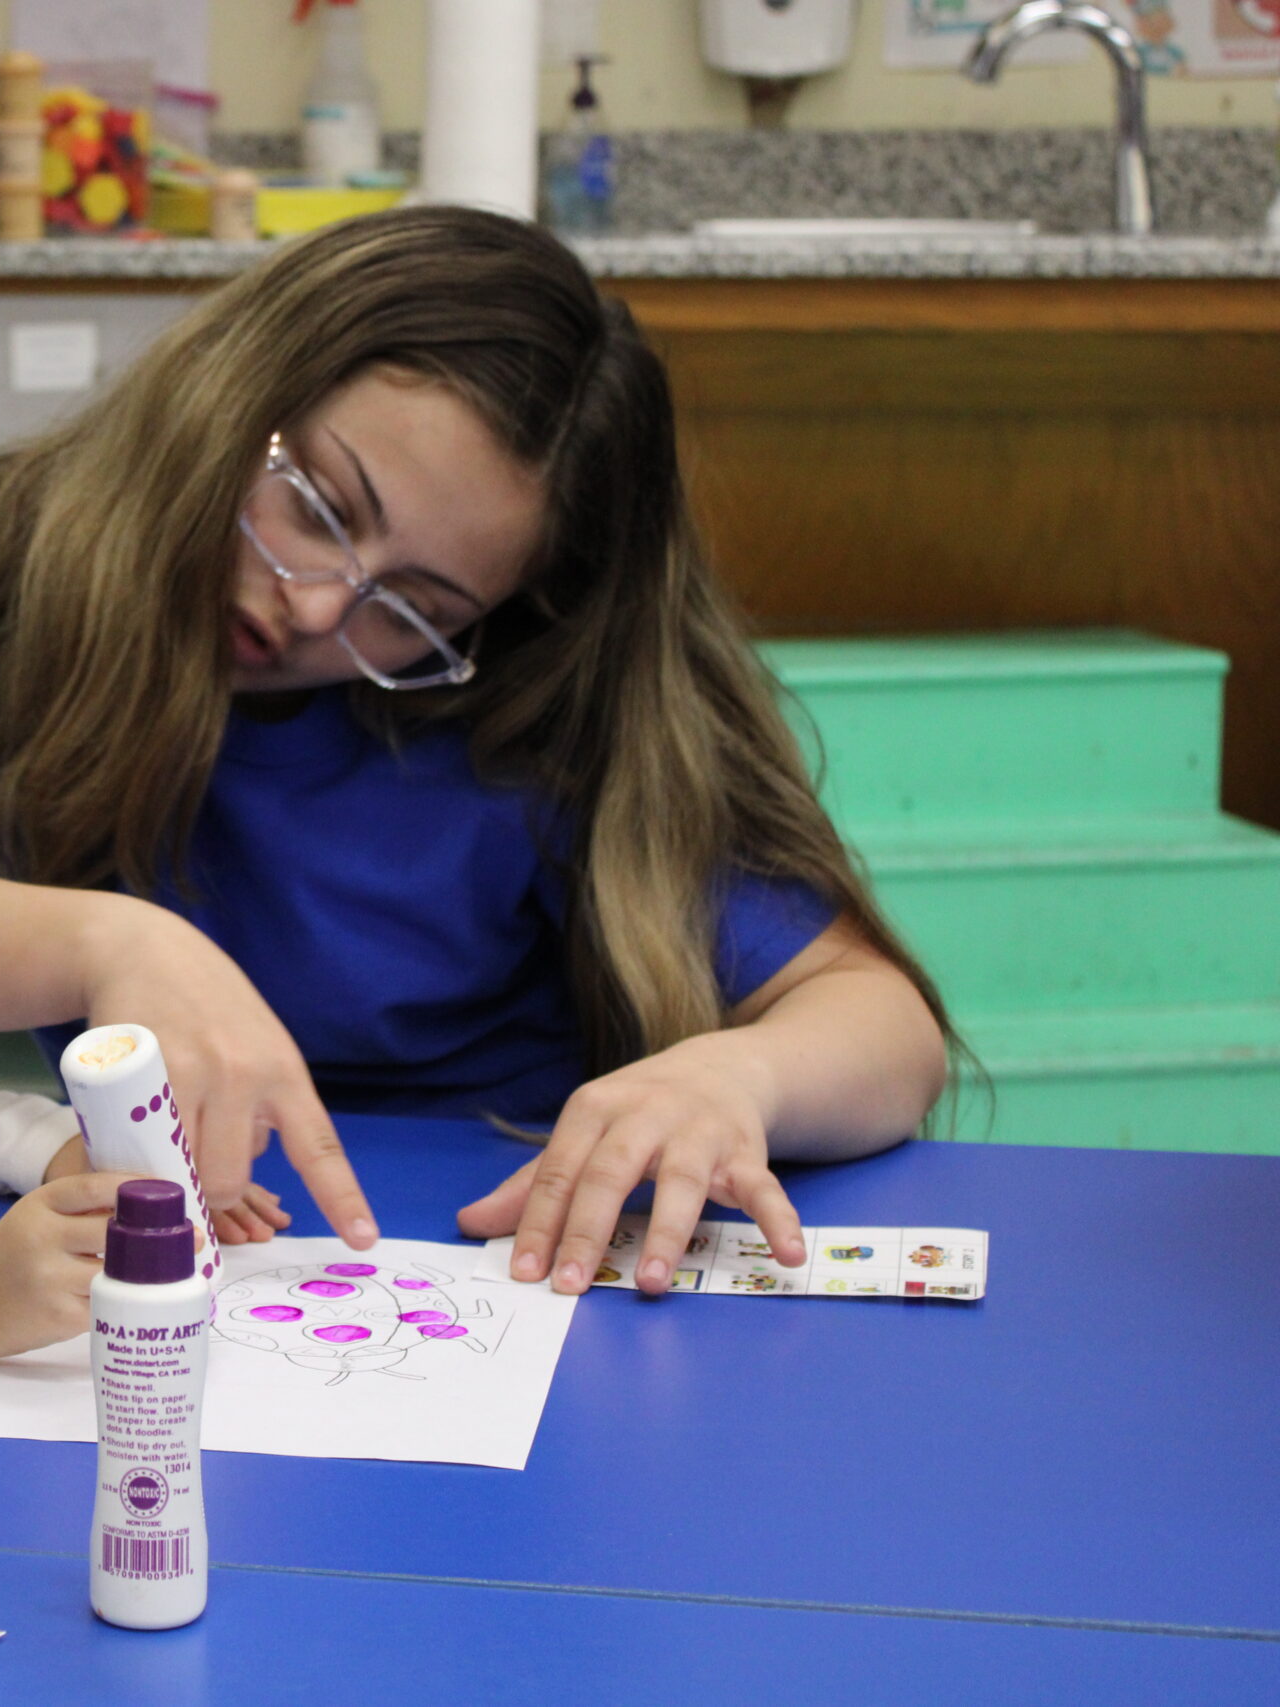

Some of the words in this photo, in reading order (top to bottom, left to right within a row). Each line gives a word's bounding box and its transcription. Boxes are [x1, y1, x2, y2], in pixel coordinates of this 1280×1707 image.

[107, 1341, 133, 1355] Made
[113, 1357, 180, 1368] www.dotart.com
[158, 1370, 169, 1378] CA
[106, 1377, 131, 1391] Shake
[106, 1390, 129, 1402] Press
[131, 1395, 143, 1404] tip
[146, 1396, 159, 1404] on
[161, 1394, 187, 1405] paper
[106, 1402, 113, 1411] to
[115, 1405, 135, 1414] start
[137, 1407, 159, 1415] flow.
[165, 1405, 183, 1415] Dab
[185, 1404, 195, 1413] tip
[106, 1414, 116, 1422] on
[118, 1416, 143, 1426] paper
[146, 1418, 156, 1426] to
[159, 1416, 187, 1426] create
[106, 1423, 123, 1433] dots
[125, 1427, 132, 1435] &
[106, 1436, 135, 1449] Should
[137, 1441, 150, 1451] tip
[152, 1442, 167, 1452] dry
[106, 1449, 139, 1461] moisten
[141, 1453, 161, 1462] with
[164, 1461, 191, 1475] 13014
[102, 1523, 135, 1538] CONFORMS
[137, 1530, 146, 1539] TO
[147, 1530, 167, 1539] ASTM
